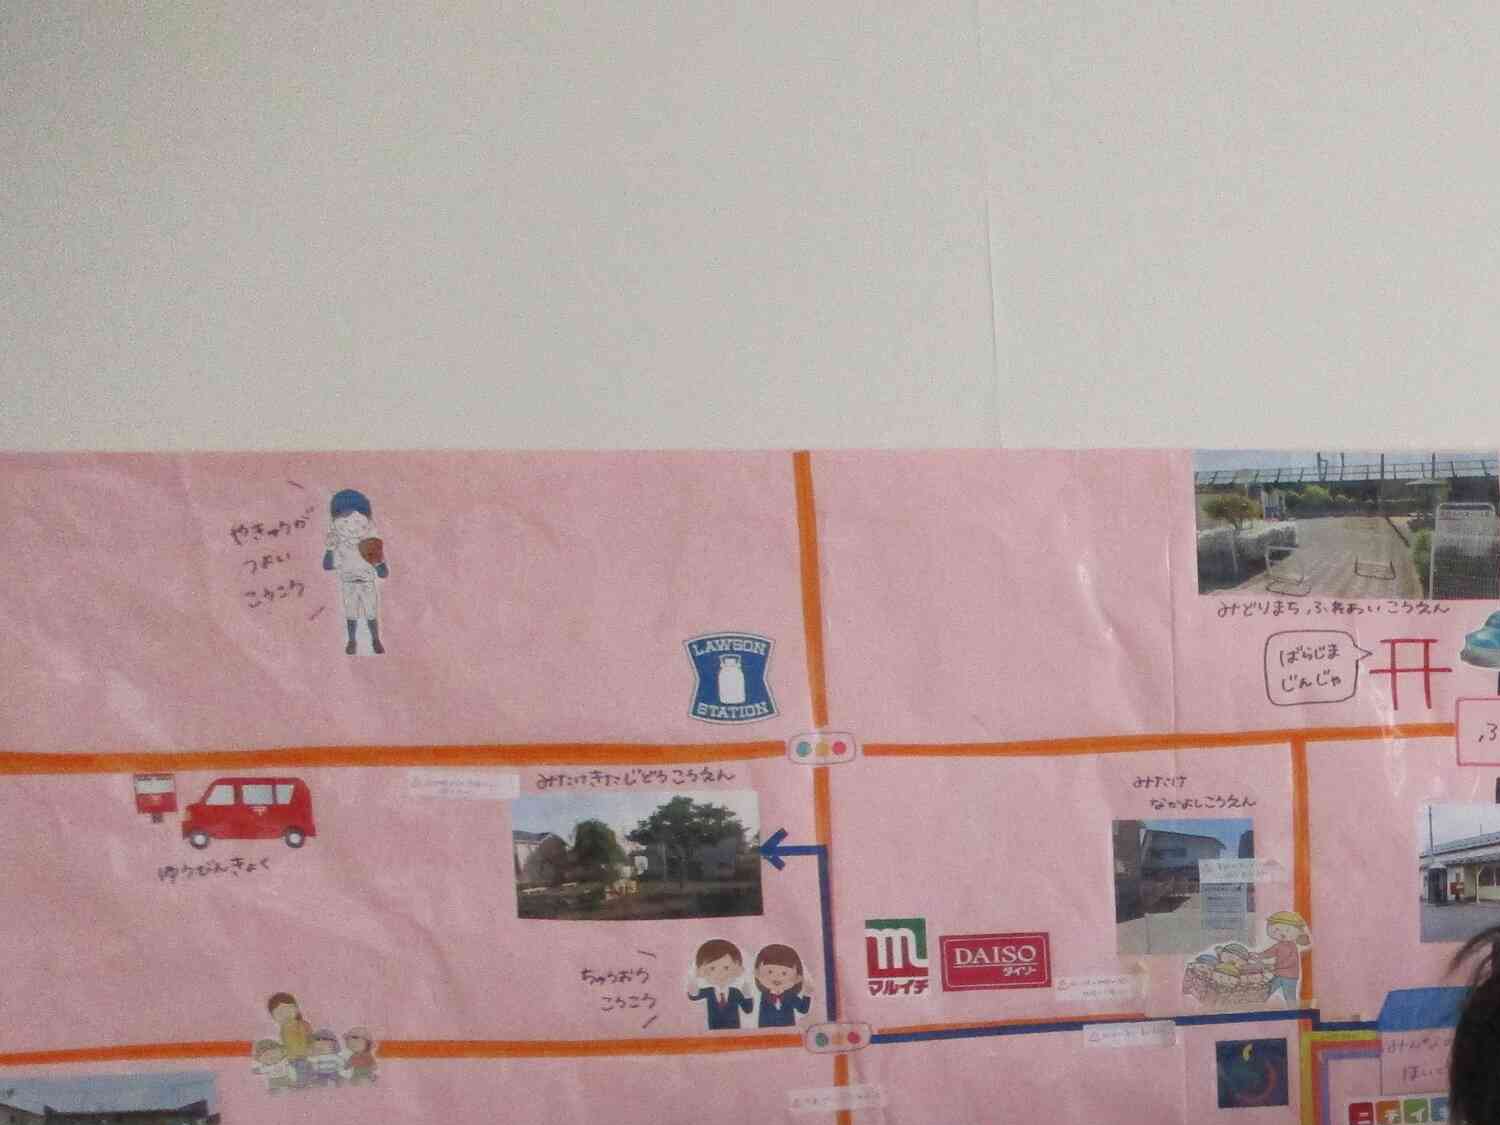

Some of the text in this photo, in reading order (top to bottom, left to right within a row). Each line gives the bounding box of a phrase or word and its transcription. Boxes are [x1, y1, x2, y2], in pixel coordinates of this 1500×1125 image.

[692, 639, 767, 657] LAWSON
[1281, 669, 1342, 692] じんじゃ
[696, 701, 769, 719] STATION
[1133, 775, 1188, 789] みたけ
[1150, 794, 1258, 811] なかよしこうえん
[954, 944, 1038, 966] DAISO
[867, 978, 930, 997] マルイチ
[600, 992, 657, 1012] こうこう
